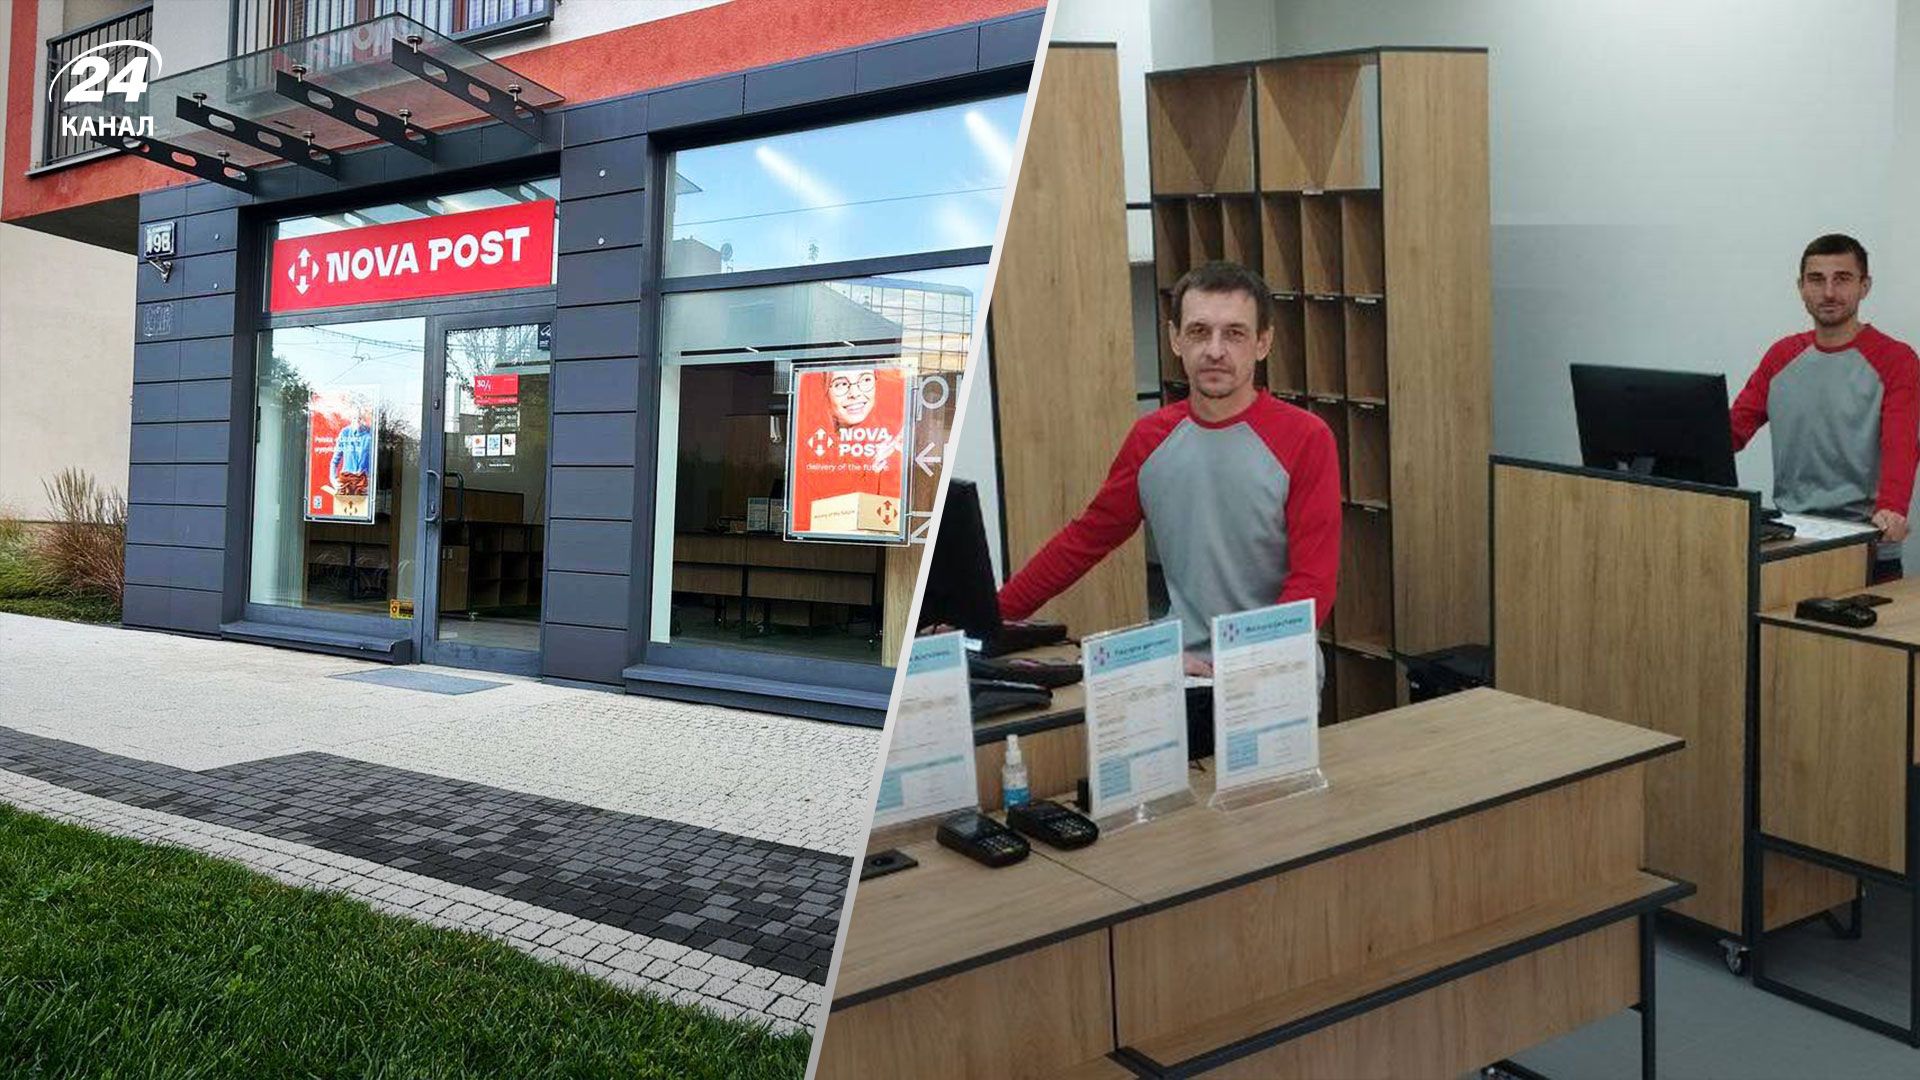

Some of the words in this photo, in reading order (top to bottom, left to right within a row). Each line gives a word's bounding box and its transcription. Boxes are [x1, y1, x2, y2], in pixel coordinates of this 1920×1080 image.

[326, 242, 419, 283] NOVA
[428, 226, 530, 271] POST
[839, 427, 891, 442] NOVA
[806, 463, 836, 473] delivery
[837, 462, 847, 471] of
[848, 463, 861, 471] the
[863, 463, 890, 472] fue
